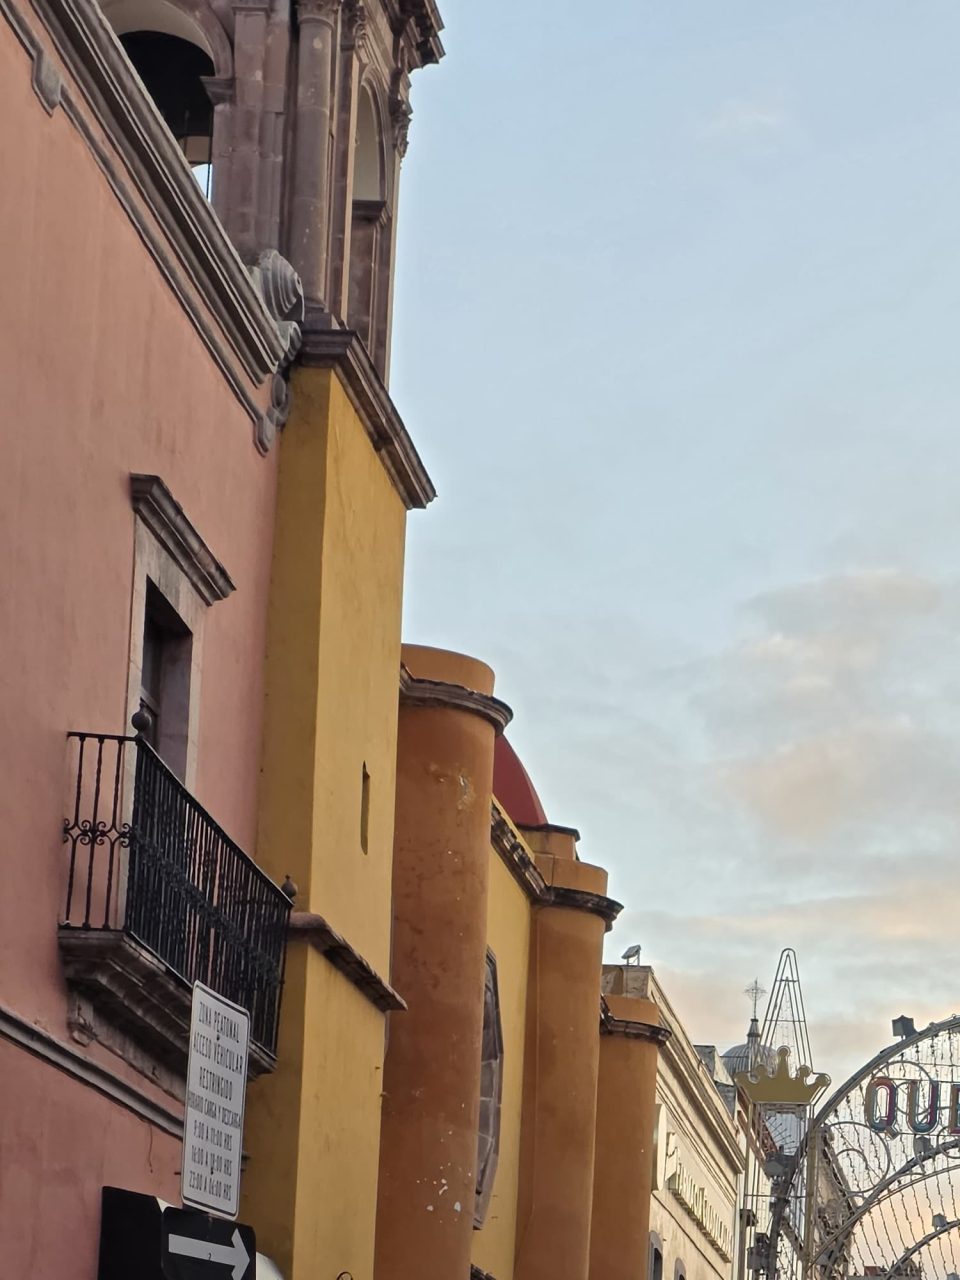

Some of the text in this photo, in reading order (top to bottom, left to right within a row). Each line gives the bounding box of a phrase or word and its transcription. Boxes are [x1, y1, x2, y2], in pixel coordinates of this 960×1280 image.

[199, 1002, 240, 1043] ZONA PEATONAL
[193, 1032, 243, 1076] ACCESO VEHICULAR
[199, 1066, 233, 1102] RESTRINGIDO
[204, 1099, 217, 1120] CARGA
[221, 1108, 241, 1129] DESCARGA
[194, 1120, 204, 1140] 9:00
[224, 1133, 233, 1152] HRS
[224, 1158, 233, 1177] HRS
[223, 1184, 232, 1202] HRS
